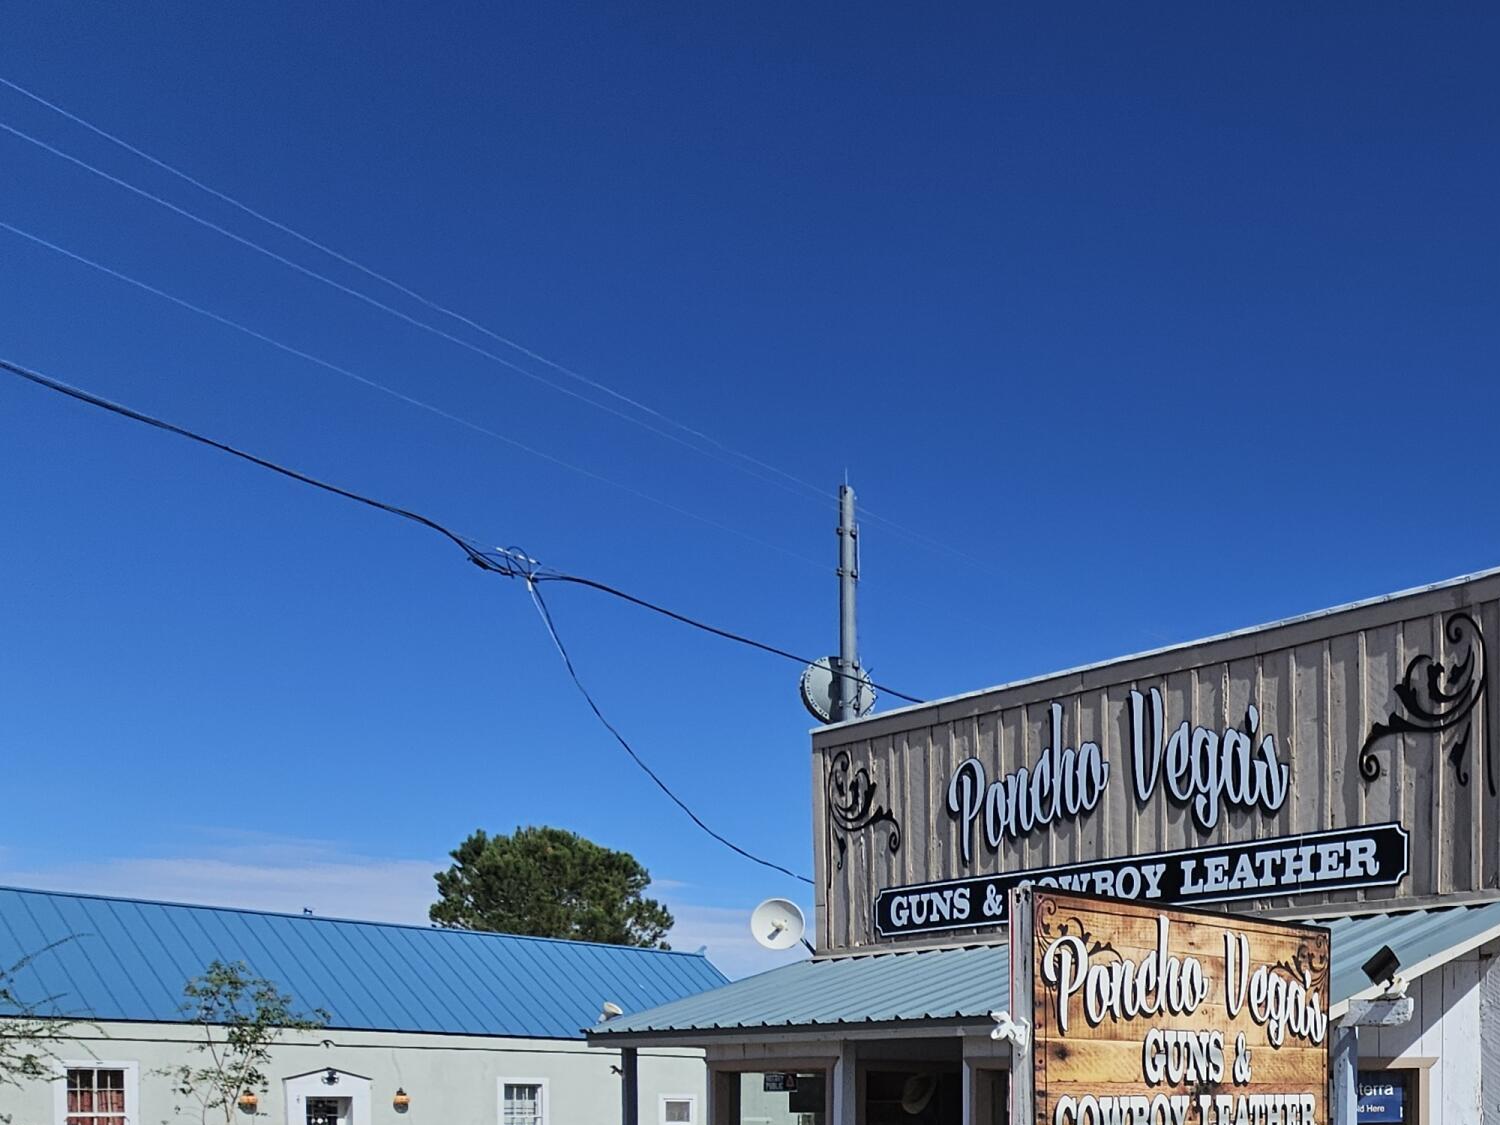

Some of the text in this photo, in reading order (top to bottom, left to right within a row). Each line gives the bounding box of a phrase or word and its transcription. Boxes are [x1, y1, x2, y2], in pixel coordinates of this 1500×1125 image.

[948, 686, 1289, 862] Poncho Vega's
[890, 838, 1380, 927] GUNS & WBOY LEATHER
[1043, 914, 1328, 1047] Poncho Vega's
[1144, 1027, 1252, 1084] GUNS &
